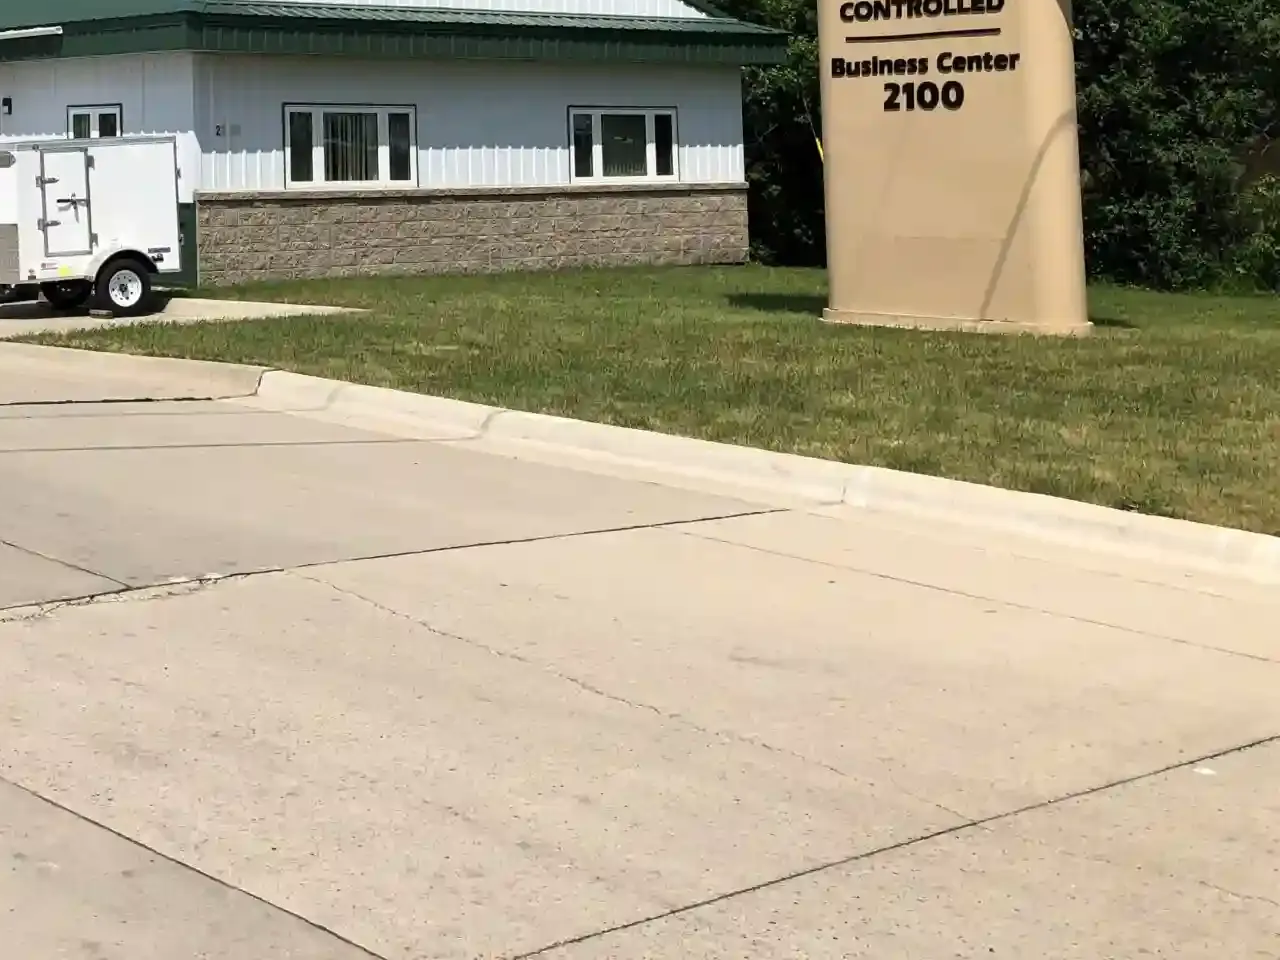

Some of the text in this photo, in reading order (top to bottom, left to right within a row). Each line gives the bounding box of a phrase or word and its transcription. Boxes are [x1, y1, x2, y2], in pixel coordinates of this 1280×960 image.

[831, 50, 1021, 79] Business Center
[883, 80, 965, 112] 2100
